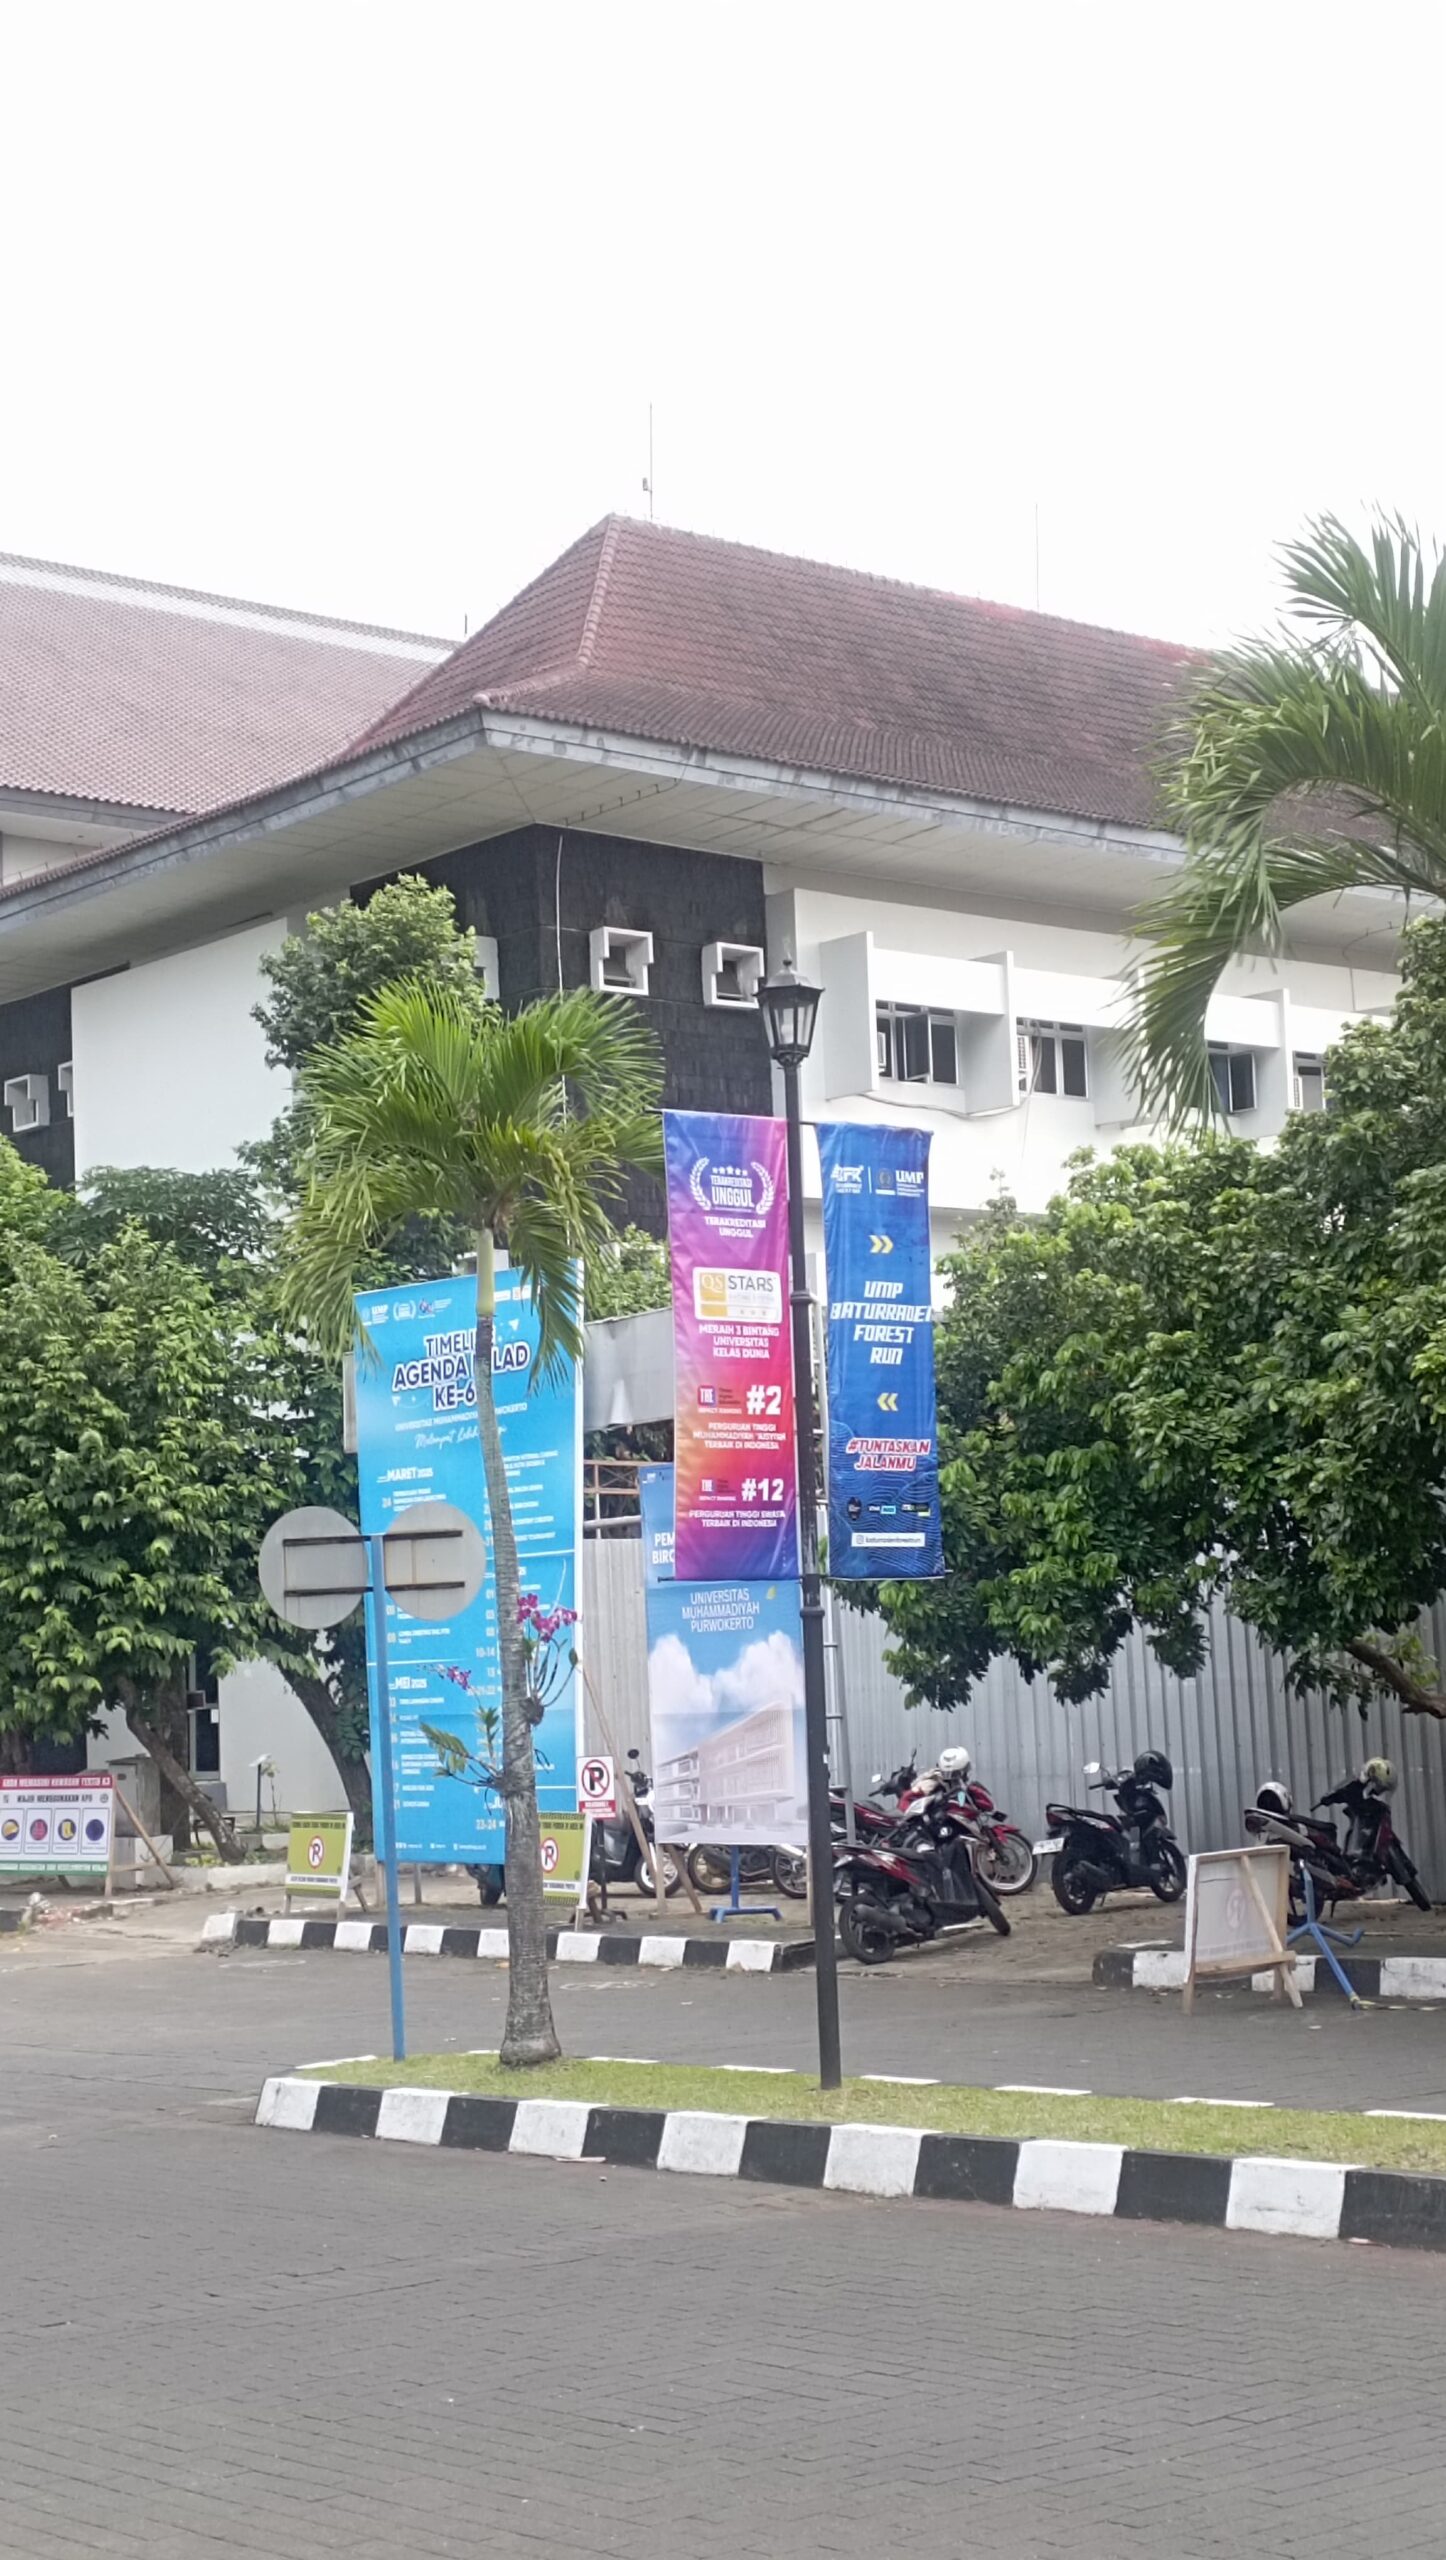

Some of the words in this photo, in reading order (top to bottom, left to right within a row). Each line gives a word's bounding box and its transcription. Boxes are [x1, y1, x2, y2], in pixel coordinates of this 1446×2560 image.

[895, 1169, 924, 1184] UMP
[712, 1187, 755, 1208] UNGGUL
[704, 1216, 766, 1228] TERAKREDITASI
[719, 1227, 754, 1238] UNGGUL
[702, 1274, 724, 1293] QS
[728, 1275, 774, 1292] STARS
[863, 1280, 903, 1299] UMP
[699, 1324, 734, 1335] MERAIH
[743, 1326, 779, 1337] BINTANG
[853, 1324, 915, 1344] FOREST
[713, 1336, 769, 1347] UNIVERSITAS
[713, 1347, 740, 1358] KELAS
[742, 1348, 770, 1359] DUNIA
[869, 1346, 903, 1365] RUN
[394, 1354, 468, 1389] AGENDA
[474, 1344, 529, 1374] LAD
[434, 1383, 476, 1408] KE-6
[746, 1384, 781, 1415] #2
[847, 1438, 931, 1455] #TUNTASKAN
[855, 1454, 917, 1471] JALANMU
[387, 1466, 417, 1481] MARET
[741, 1478, 784, 1502] #12
[690, 1588, 750, 1605] UNIVERSITAS
[682, 1601, 760, 1619] MUHAMMADIYAH
[691, 1616, 754, 1632] PURWOKERTO
